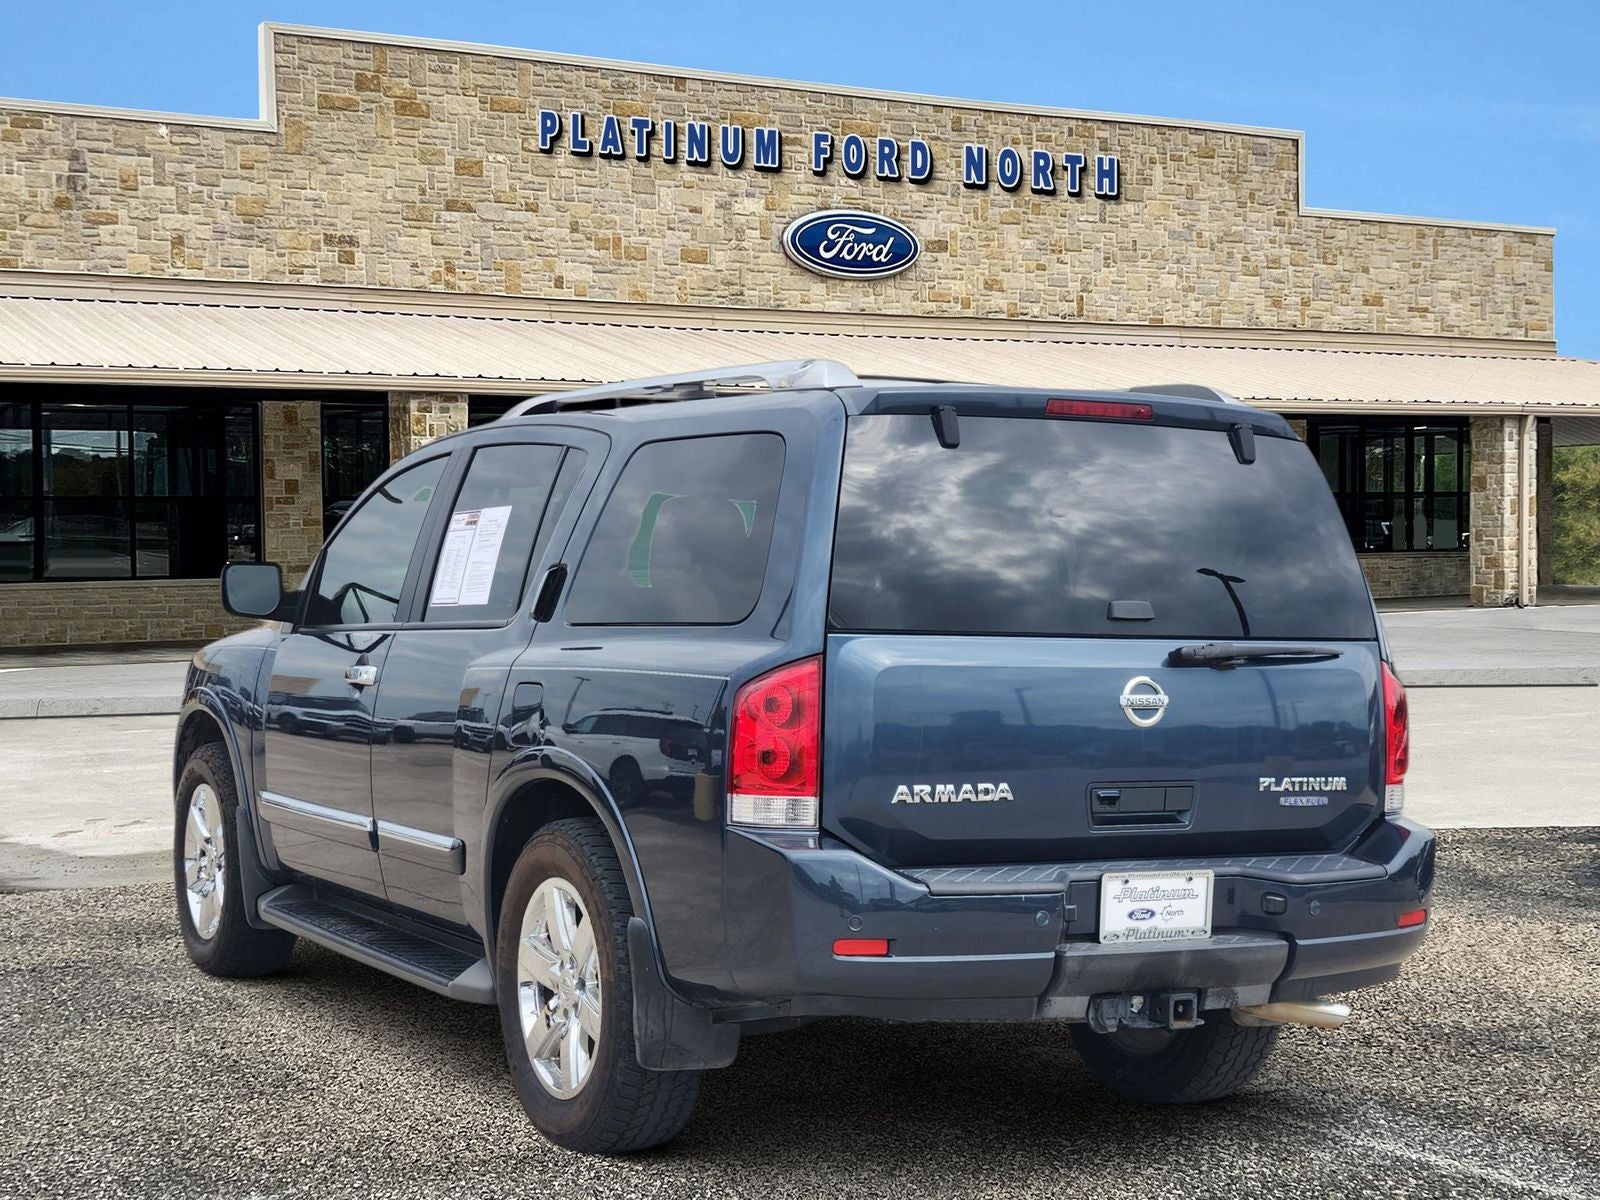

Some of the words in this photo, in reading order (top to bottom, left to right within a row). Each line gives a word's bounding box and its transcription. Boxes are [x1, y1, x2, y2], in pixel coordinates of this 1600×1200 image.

[538, 110, 780, 171] PLATINUM
[812, 132, 932, 183] FORD
[963, 145, 1121, 199] NORTH
[818, 222, 895, 265] Ford
[1126, 697, 1165, 706] NISSAN
[1259, 777, 1347, 791] PLATINUM
[891, 782, 1015, 805] ARMADA
[1113, 886, 1199, 903] Platinum
[1132, 910, 1151, 919] Ford
[1166, 909, 1184, 917] North
[1124, 926, 1188, 940] Platinum
